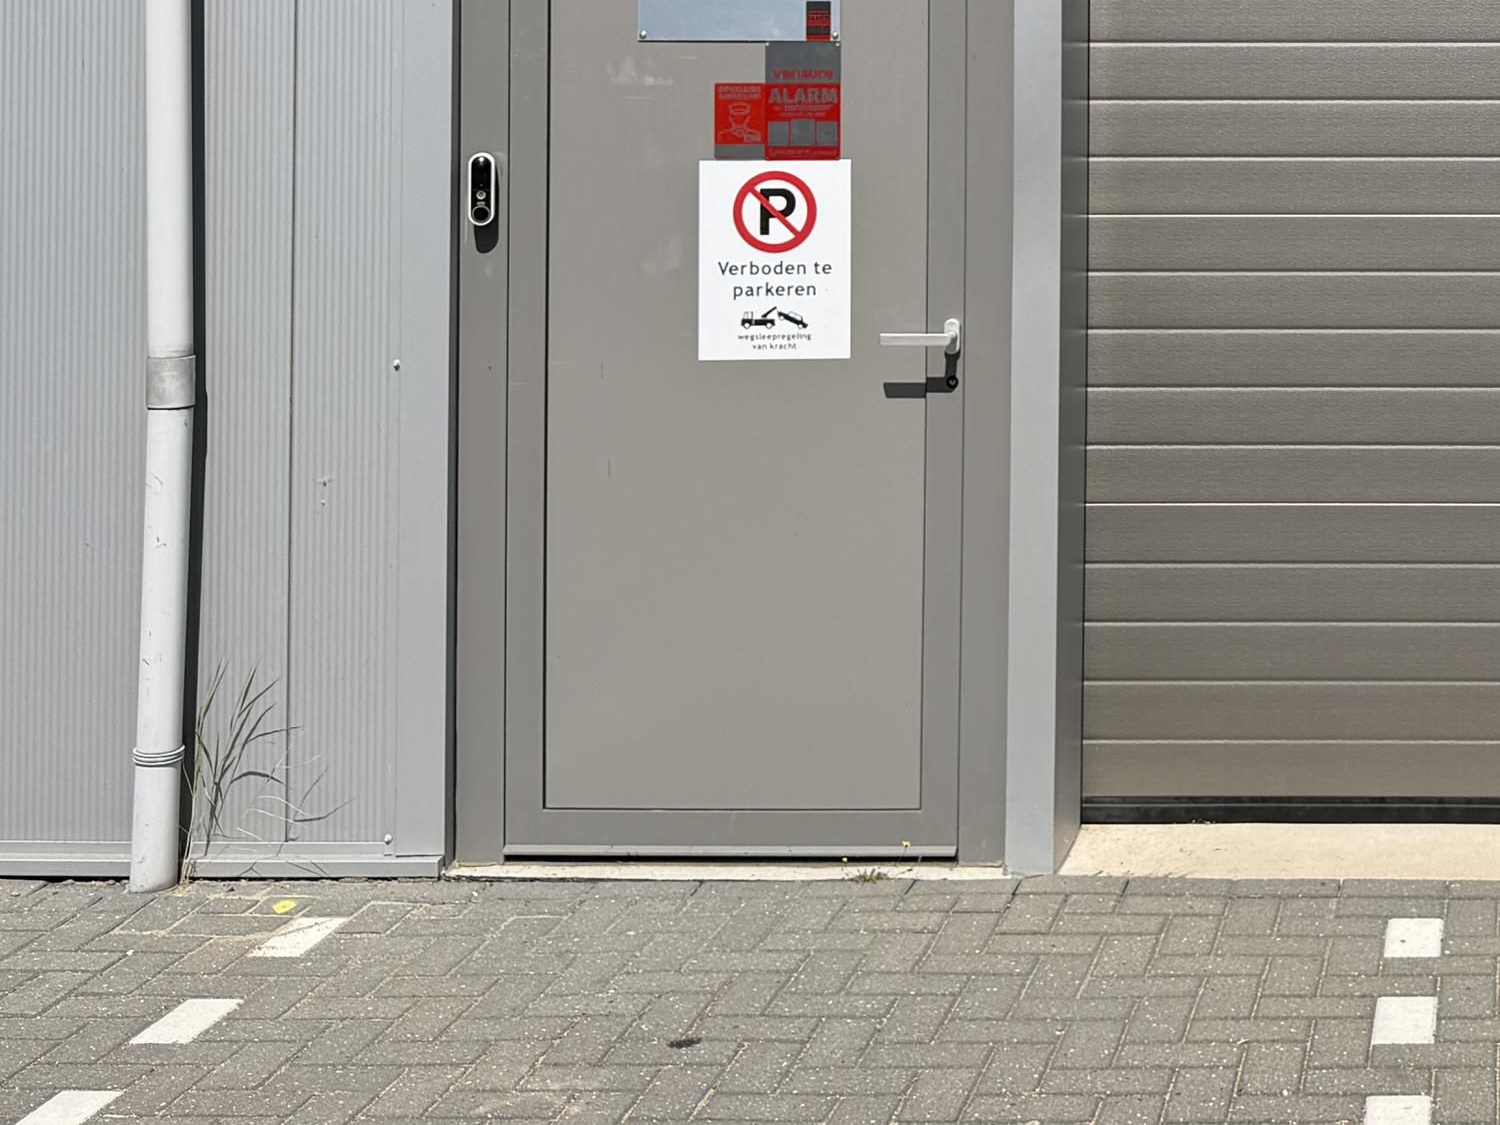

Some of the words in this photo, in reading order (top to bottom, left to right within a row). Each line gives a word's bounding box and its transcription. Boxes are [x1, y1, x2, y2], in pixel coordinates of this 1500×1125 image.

[768, 87, 838, 104] ALARM
[760, 188, 796, 235] P
[717, 260, 806, 276] Verboden
[814, 261, 832, 275] te
[733, 282, 817, 300] parkeren
[737, 332, 812, 342] wegsleepregeling
[769, 342, 797, 350] kracht
